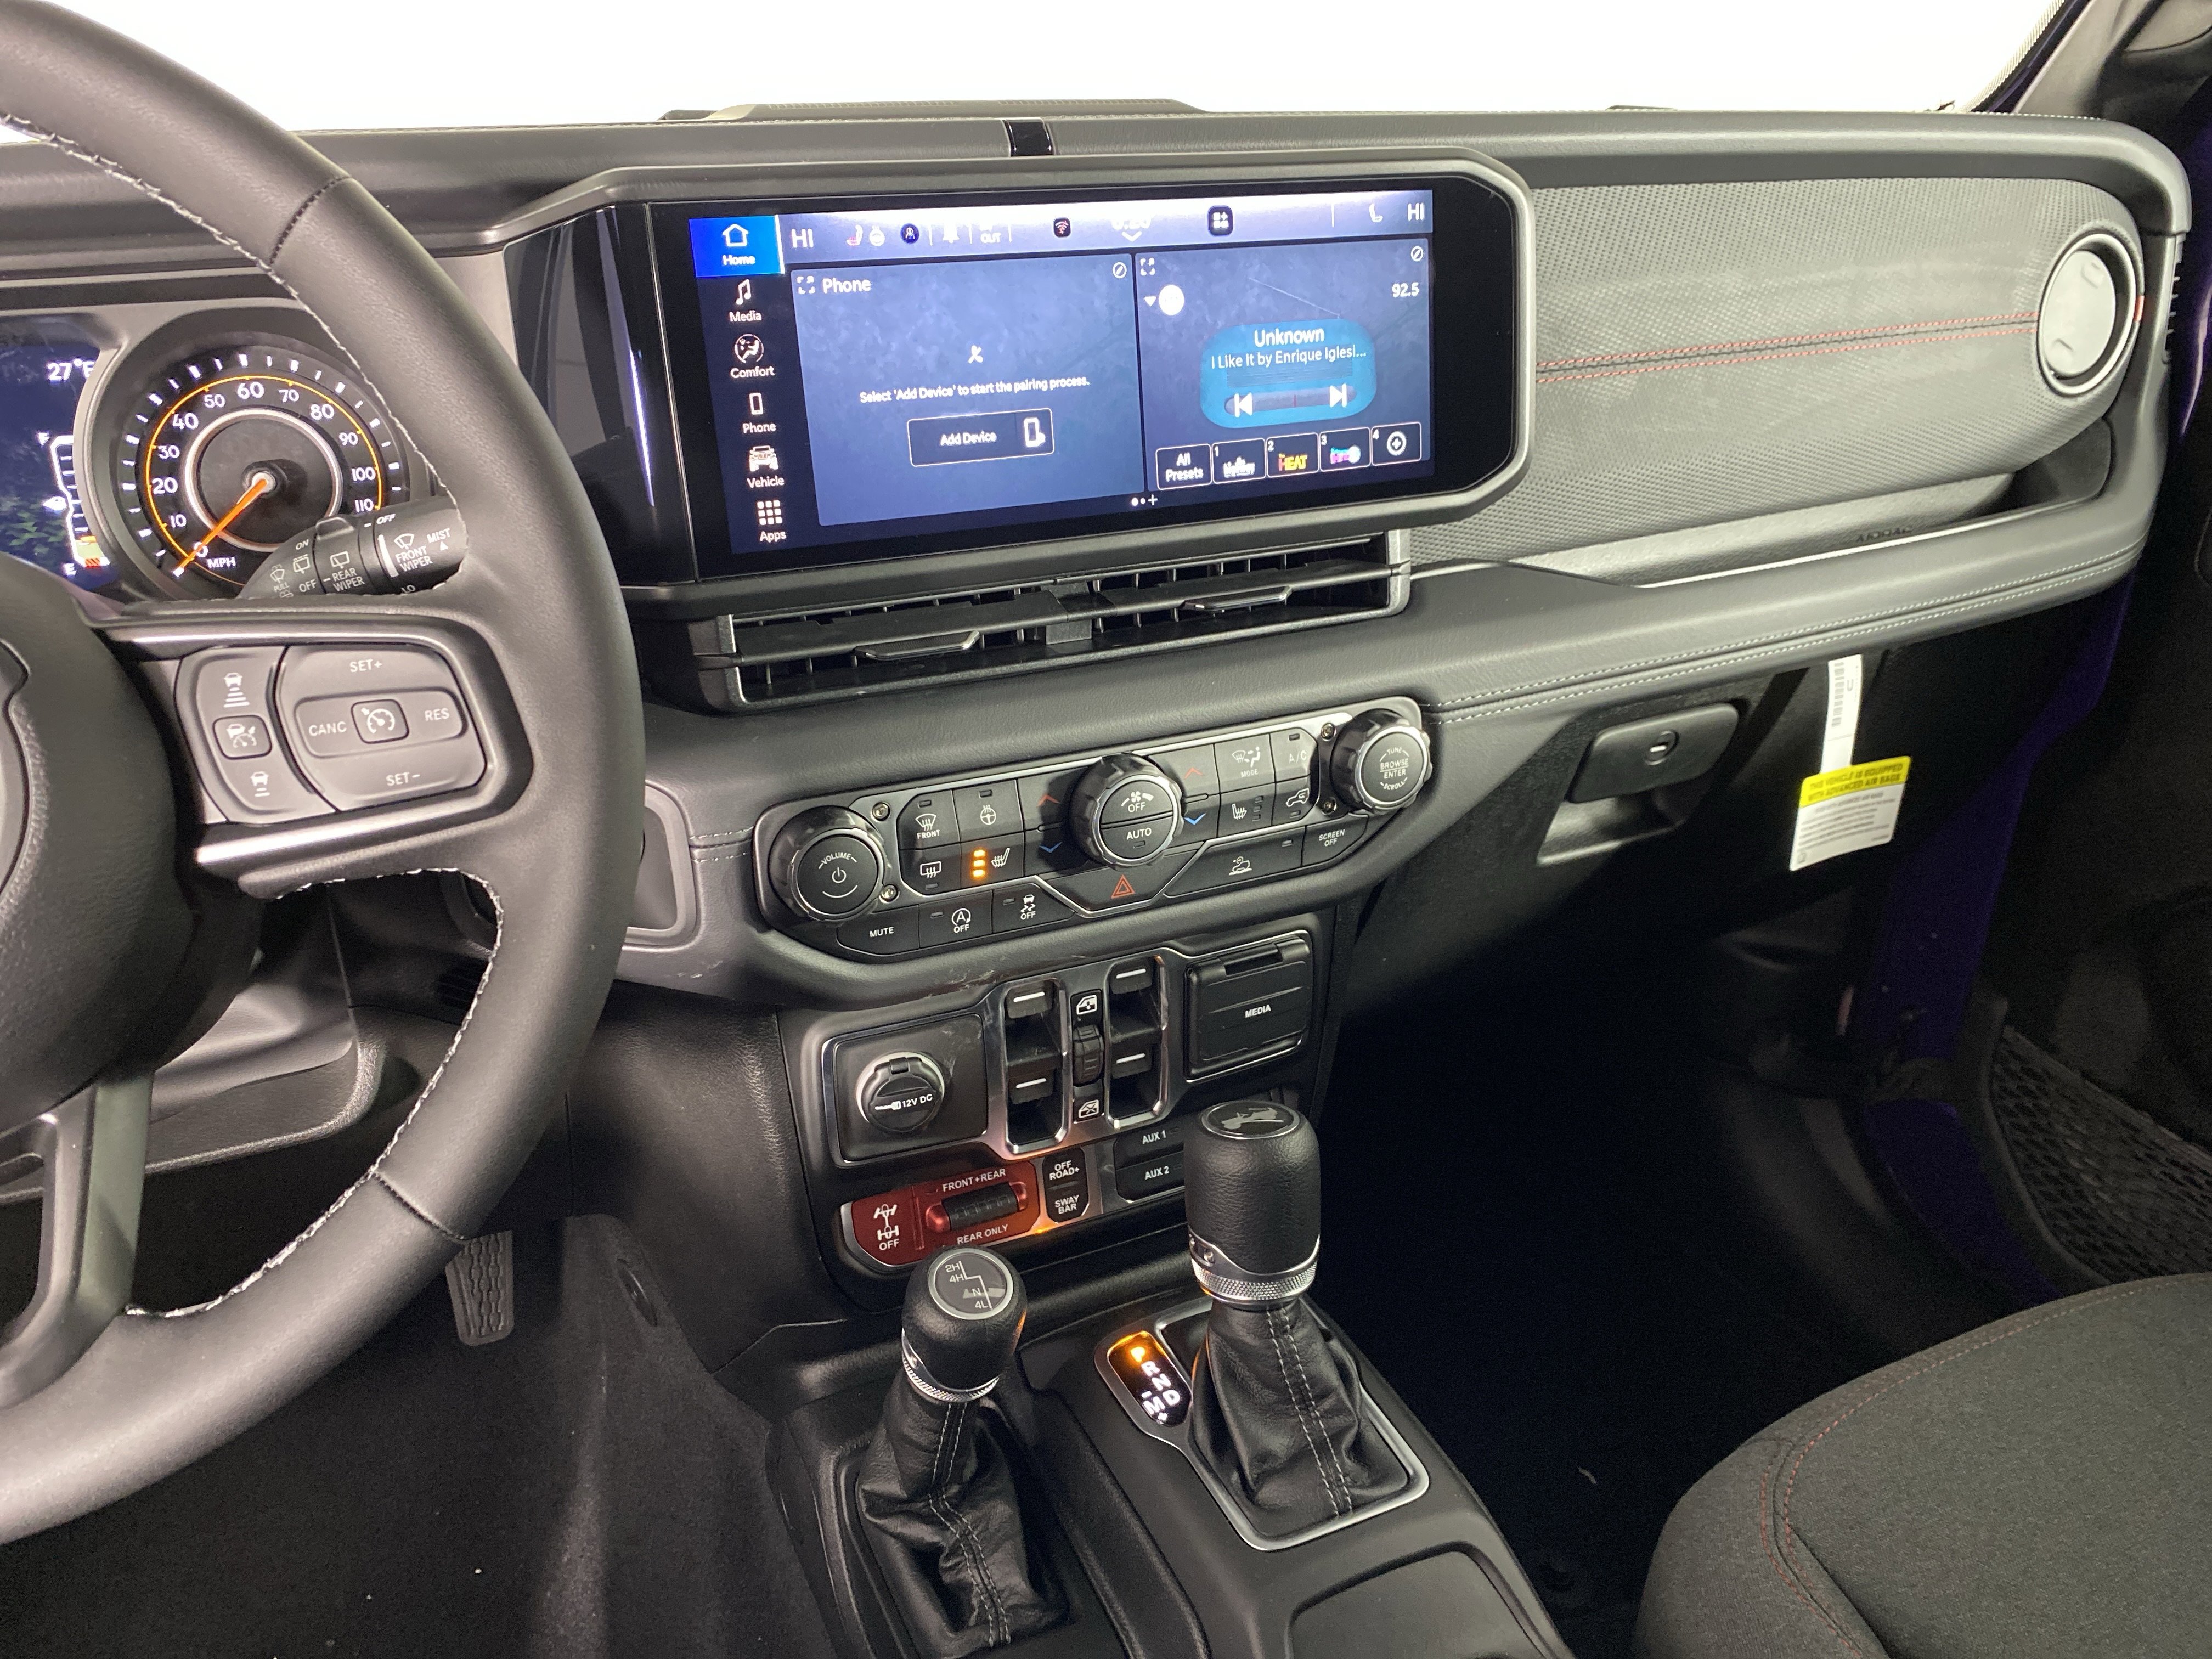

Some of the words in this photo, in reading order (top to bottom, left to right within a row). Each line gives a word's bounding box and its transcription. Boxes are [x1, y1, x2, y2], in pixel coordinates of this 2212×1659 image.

[1407, 203, 1425, 221] HI
[791, 228, 814, 248] HI
[980, 232, 1001, 243] OUT
[722, 254, 755, 266] Home
[822, 278, 871, 294] Phone
[1392, 282, 1419, 297] 92.5
[729, 310, 762, 322] Media
[1254, 328, 1325, 347] Unknown
[1211, 356, 1215, 369] I
[1218, 354, 1243, 369] Like
[1246, 353, 1255, 366] It
[1257, 352, 1272, 368] by
[1275, 349, 1322, 365] Enrique
[730, 365, 775, 379] Comfort
[238, 381, 264, 399] 60
[279, 389, 299, 403] 70
[860, 390, 892, 404] Select
[894, 388, 917, 400] 'Add
[919, 385, 956, 399] Device'
[957, 385, 968, 395] to
[970, 382, 995, 395] start
[996, 381, 1012, 392] the
[1014, 379, 1048, 394] pairing
[1049, 376, 1091, 391] process.
[204, 394, 226, 408] 50
[311, 403, 335, 420] 80
[172, 413, 199, 431] 40
[742, 422, 776, 434] Phone
[38, 432, 49, 446] F
[339, 432, 358, 445] 90
[940, 433, 962, 446] Add
[962, 431, 997, 444] Device
[1321, 435, 1327, 445] 3
[159, 445, 180, 460] 30
[1215, 445, 1219, 457] 1
[1267, 440, 1274, 452] 2
[1176, 452, 1190, 466] All
[1279, 454, 1308, 472] HEAT
[352, 466, 376, 481] 100
[1165, 466, 1204, 482] Presets
[153, 477, 178, 494] 20
[746, 476, 785, 488] Vehicle
[354, 499, 374, 512] 110
[170, 515, 187, 528] 10
[376, 514, 396, 524] OFF
[427, 528, 450, 544] MIST
[759, 531, 787, 544] Apps
[295, 539, 309, 550] ON
[395, 545, 427, 563] FRONT
[207, 556, 236, 568] MPH
[399, 556, 433, 572] WIPER
[64, 563, 77, 577] E
[331, 567, 357, 582] REAR
[274, 582, 290, 592] PULL
[299, 579, 316, 592] OFF
[332, 577, 365, 592] WIPER
[424, 708, 449, 721] RES
[308, 721, 347, 737] CANC
[1289, 750, 1307, 764] A/C
[1386, 747, 1402, 755] TUNE
[1380, 758, 1409, 770] BROWSE
[1240, 769, 1259, 777] MODE
[1384, 769, 1406, 779] ENTER
[1384, 781, 1406, 791] SCROLL
[1128, 802, 1146, 812] OFF
[917, 830, 940, 839] FRONT
[1127, 827, 1152, 840] AUTO
[1318, 829, 1345, 841] SCREEN
[1324, 838, 1338, 847] OFF
[821, 851, 851, 865] VOLUME
[1020, 911, 1036, 920] OFF
[870, 927, 894, 938] MUTE
[953, 924, 969, 933] OFF
[1245, 1004, 1271, 1018] MEDIA
[901, 1098, 918, 1108] 12V
[919, 1093, 933, 1104] DC
[1142, 1131, 1161, 1144] AUX
[1162, 1130, 1166, 1138] 1
[1054, 1160, 1071, 1171] OFF
[1049, 1166, 1080, 1180] ROAD+
[1144, 1167, 1163, 1180] AUX
[1164, 1166, 1170, 1175] 2
[1054, 1194, 1079, 1208] SWAY
[1058, 1204, 1077, 1215] BAR
[957, 1231, 983, 1245] REAR
[985, 1224, 1008, 1237] ONLY
[879, 1238, 900, 1251] OFF
[945, 1262, 960, 1273] 2H
[949, 1273, 964, 1283] 4H
[972, 1287, 981, 1296] N
[975, 1300, 988, 1309] 4L
[1130, 1346, 1146, 1363] P
[1141, 1361, 1160, 1377] R
[1152, 1373, 1171, 1391] N
[1143, 1396, 1165, 1414] M
[1162, 1390, 1180, 1407] D
